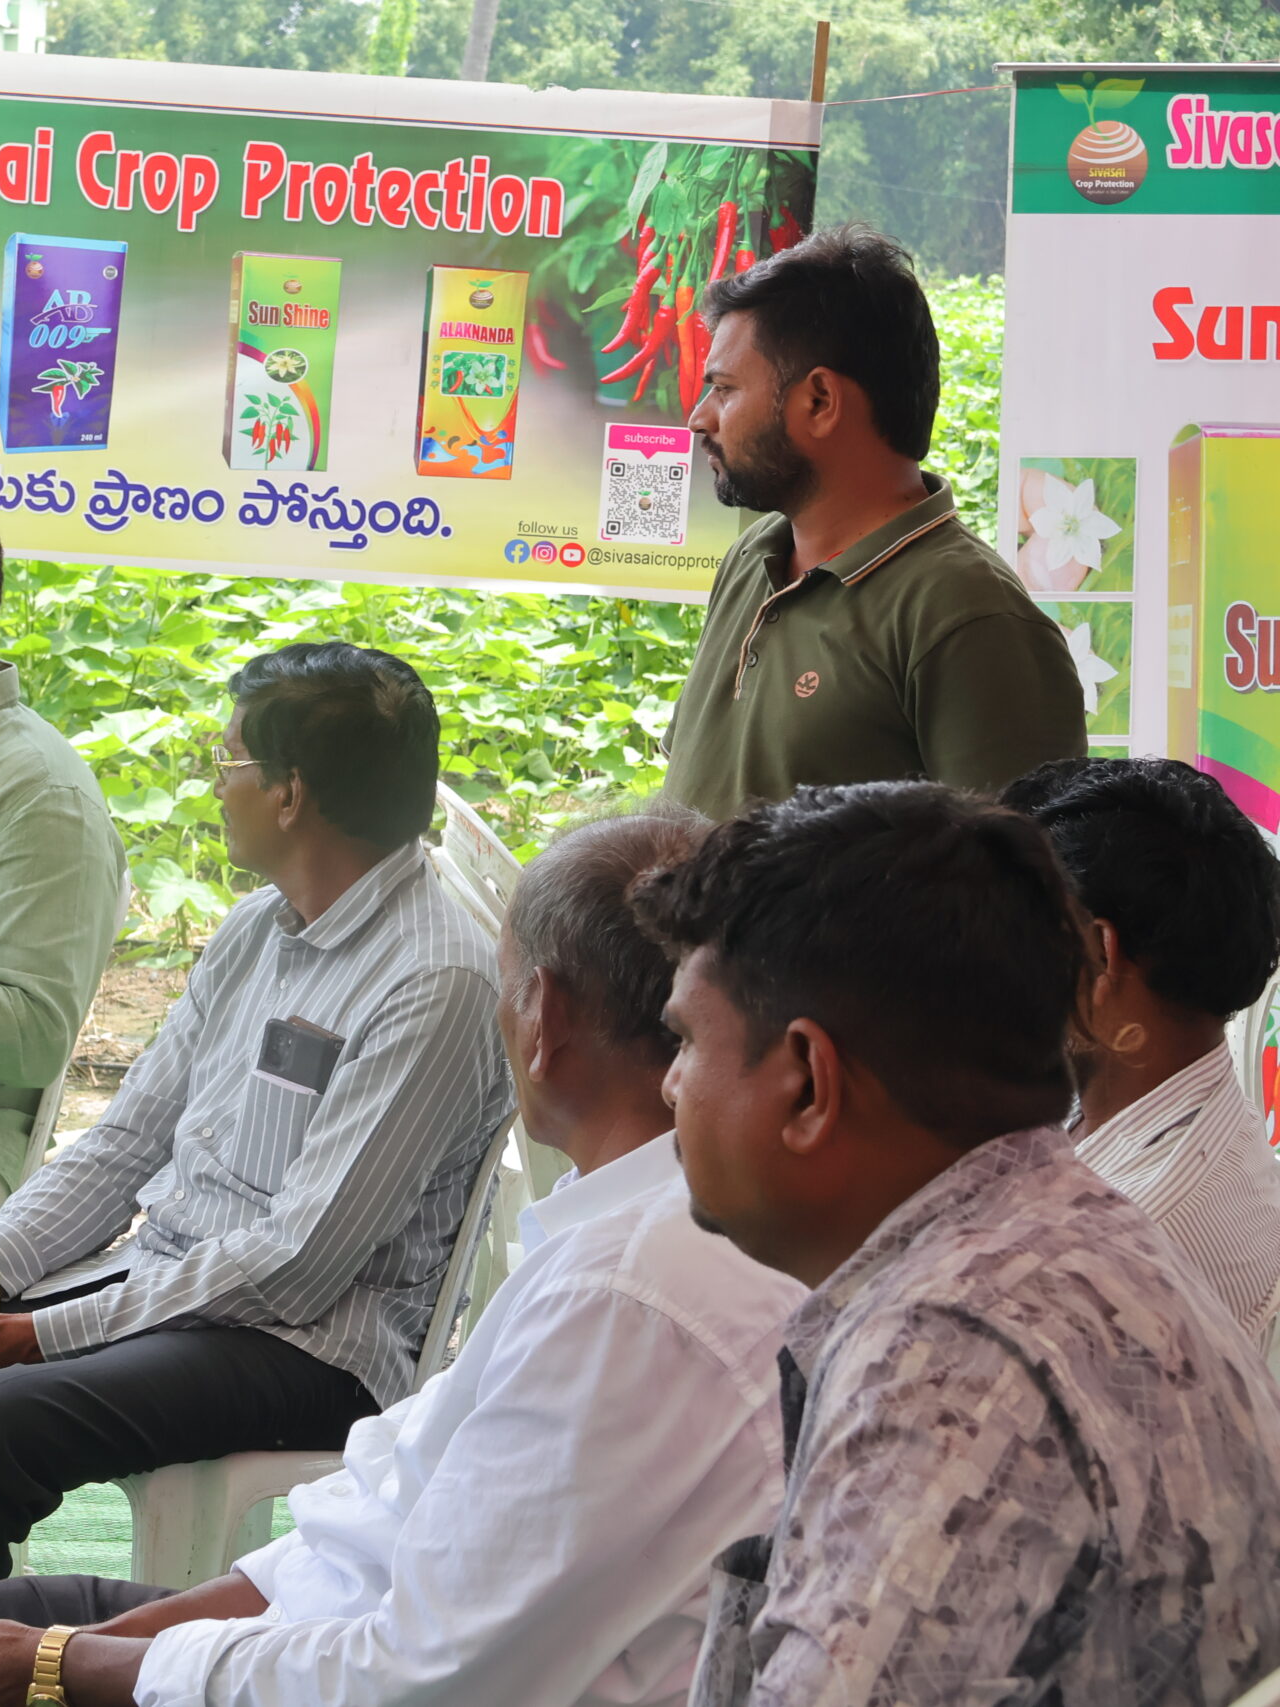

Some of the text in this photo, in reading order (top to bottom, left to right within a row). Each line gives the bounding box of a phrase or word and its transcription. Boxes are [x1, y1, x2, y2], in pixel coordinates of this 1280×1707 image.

[1166, 94, 1280, 169] Sivas
[76, 131, 219, 232] Crop
[241, 140, 565, 238] Protection
[1075, 180, 1135, 190] Crop Protection
[1088, 167, 1126, 178] SIVASAI
[30, 289, 98, 325] AB
[248, 300, 330, 330] Sun Shine
[439, 321, 516, 344] ALAKNANDA
[1152, 286, 1280, 361] Sun
[80, 433, 103, 442] 240 ml
[624, 432, 677, 445] subscribe
[84, 469, 225, 532] ప్రాణం
[238, 479, 453, 550] పోస్తుంది.
[518, 521, 578, 536] follow us
